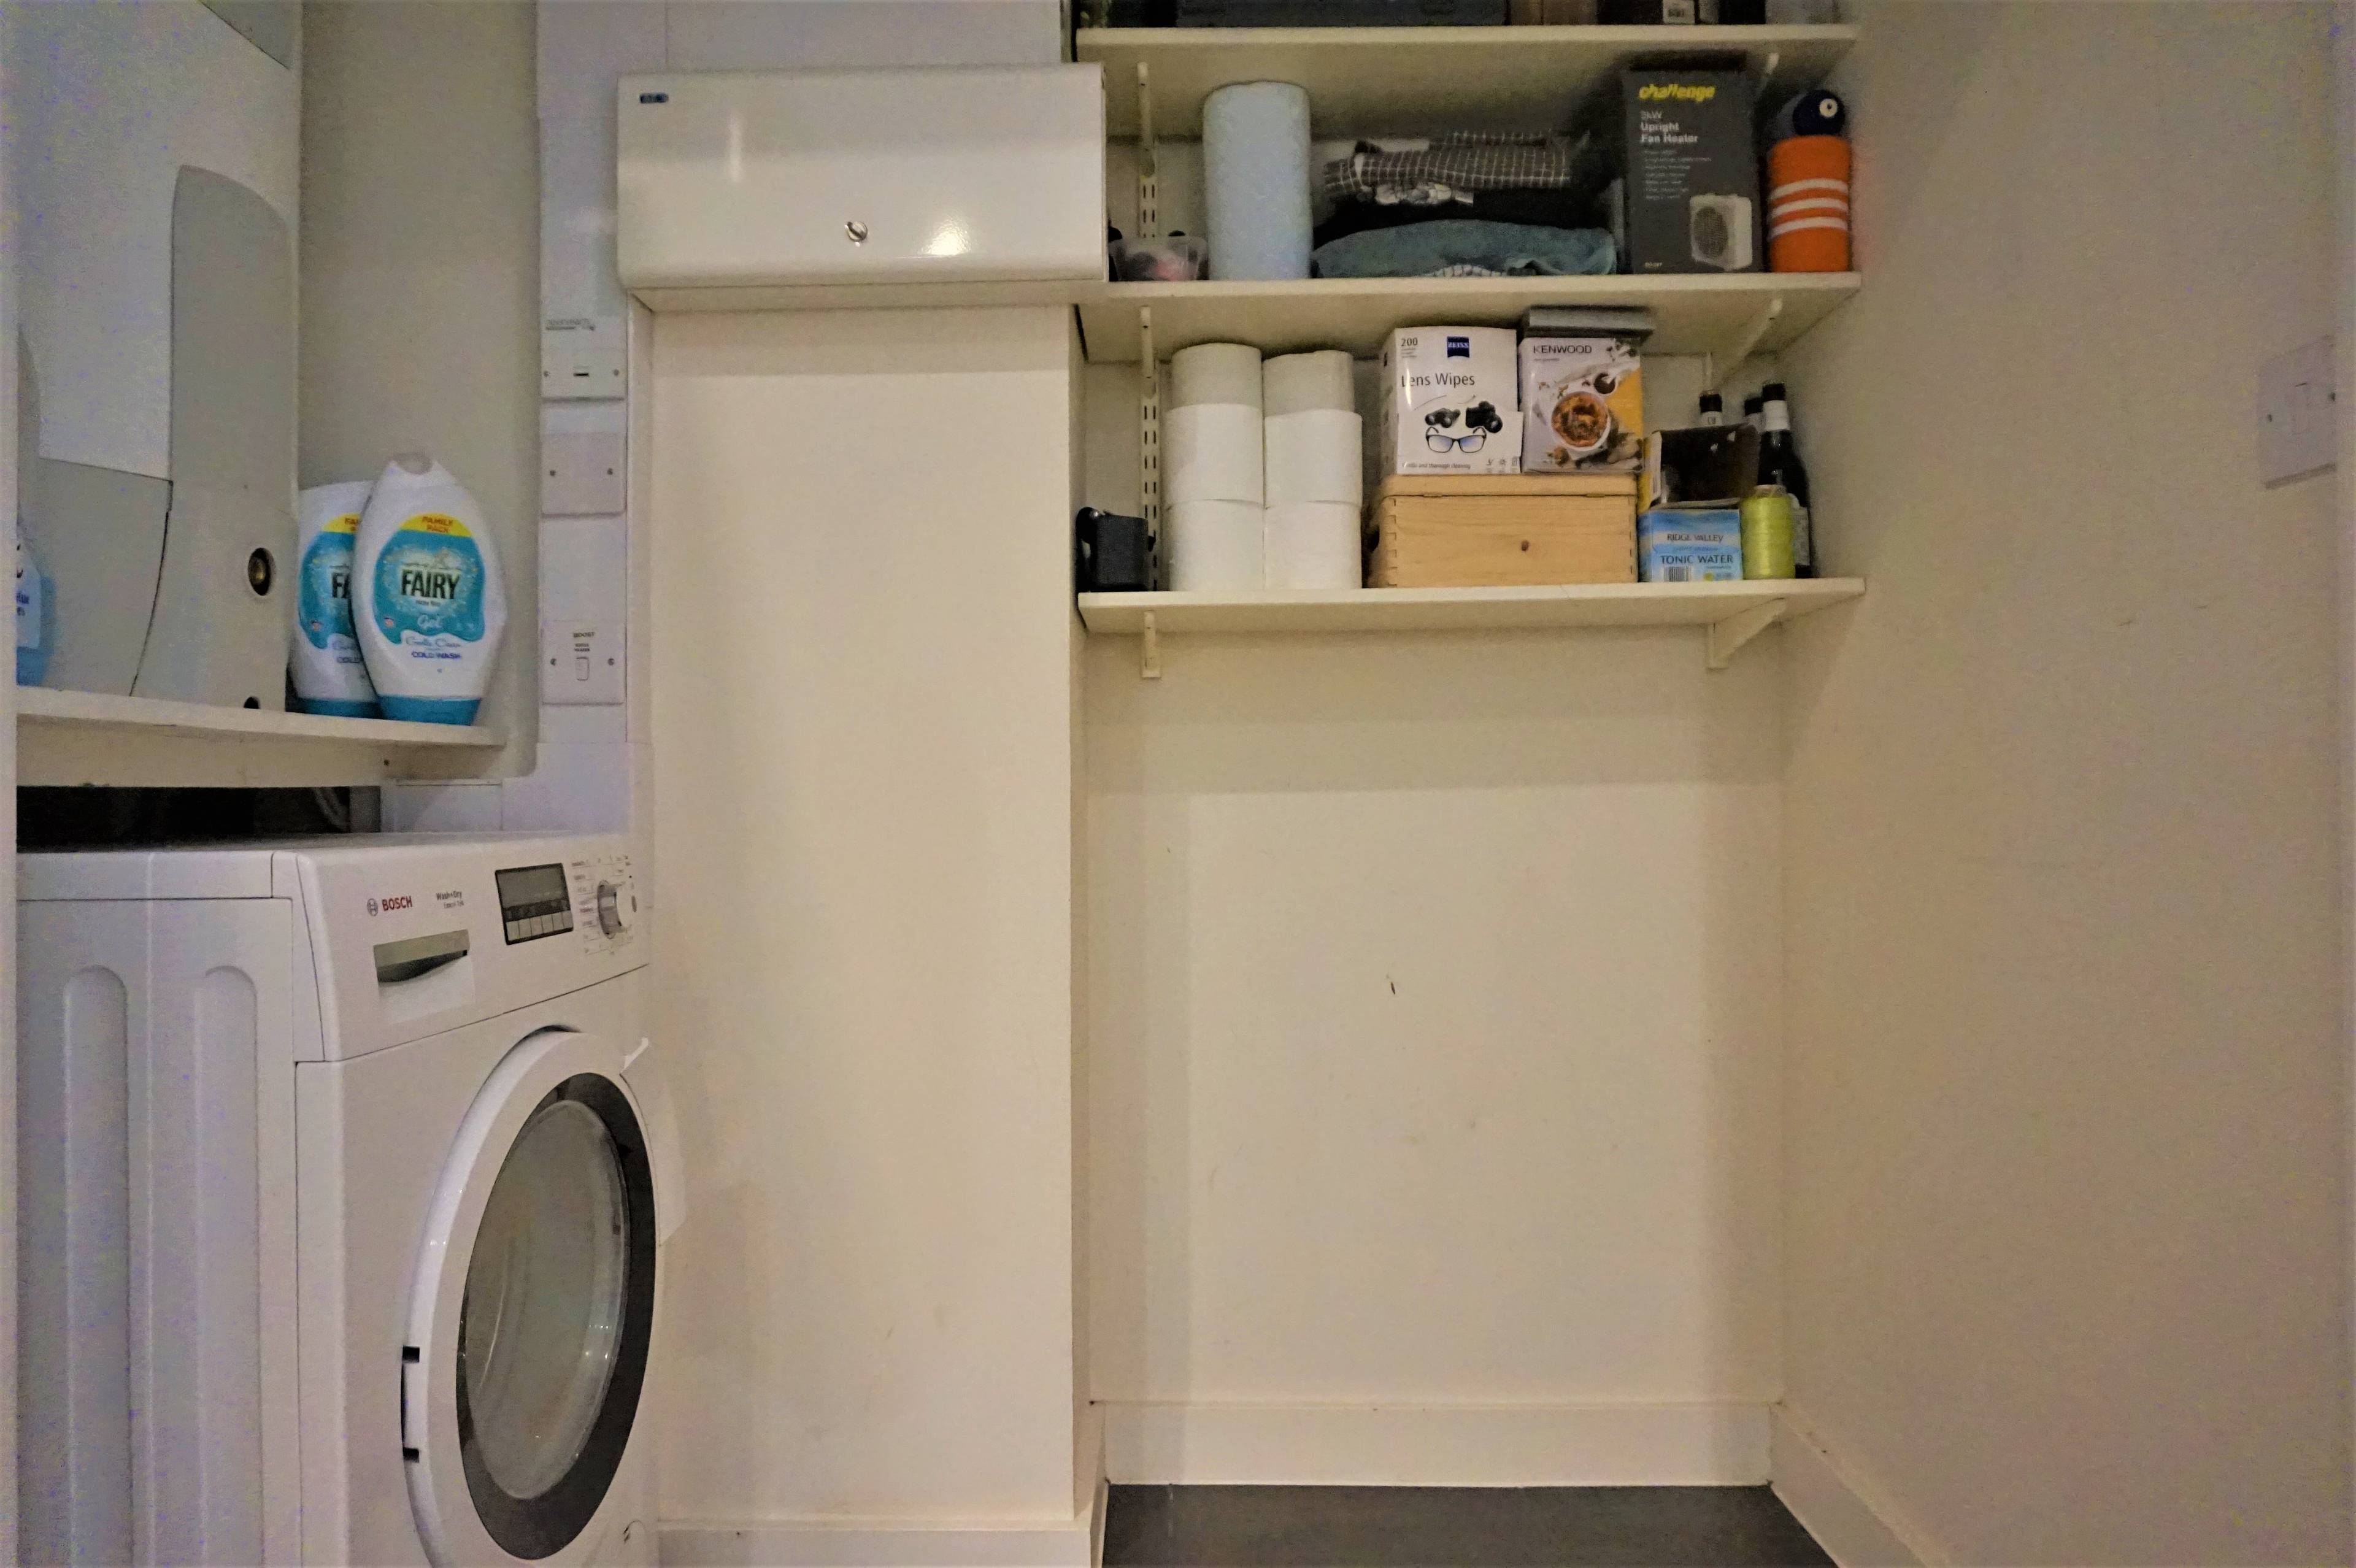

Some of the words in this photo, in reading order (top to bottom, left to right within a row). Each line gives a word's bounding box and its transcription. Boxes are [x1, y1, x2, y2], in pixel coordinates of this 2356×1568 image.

[1639, 83, 1715, 103] challenge
[1640, 122, 1680, 133] Upright
[1640, 134, 1660, 144] Fan
[1663, 133, 1698, 143] Heater
[1401, 337, 1418, 347] 200
[1533, 345, 1592, 353] KENWOOD
[1401, 375, 1431, 388] Lens
[1434, 372, 1475, 388] Wipes
[1694, 534, 1723, 543] VALLEY
[1660, 555, 1693, 564] TONIC
[1697, 554, 1733, 564] WATER
[402, 568, 460, 599] FAIRY
[382, 896, 413, 912] BOSCH
